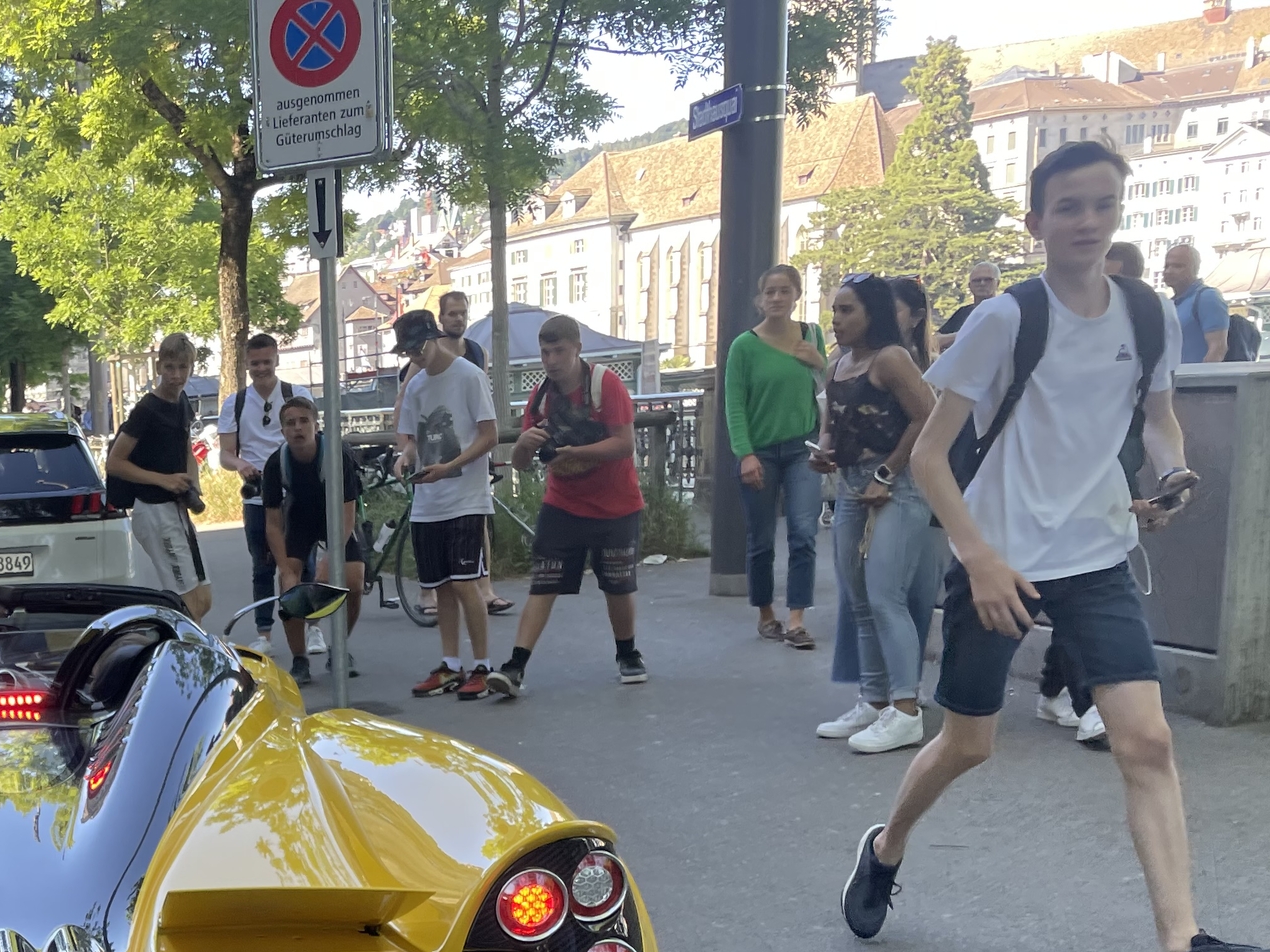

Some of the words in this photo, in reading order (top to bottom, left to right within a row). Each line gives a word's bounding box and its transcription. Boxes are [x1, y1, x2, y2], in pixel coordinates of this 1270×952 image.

[276, 88, 360, 111] ausgenommen
[273, 110, 336, 129] Lieferanten
[340, 106, 364, 119] zum
[276, 123, 362, 147] Güterumschlag
